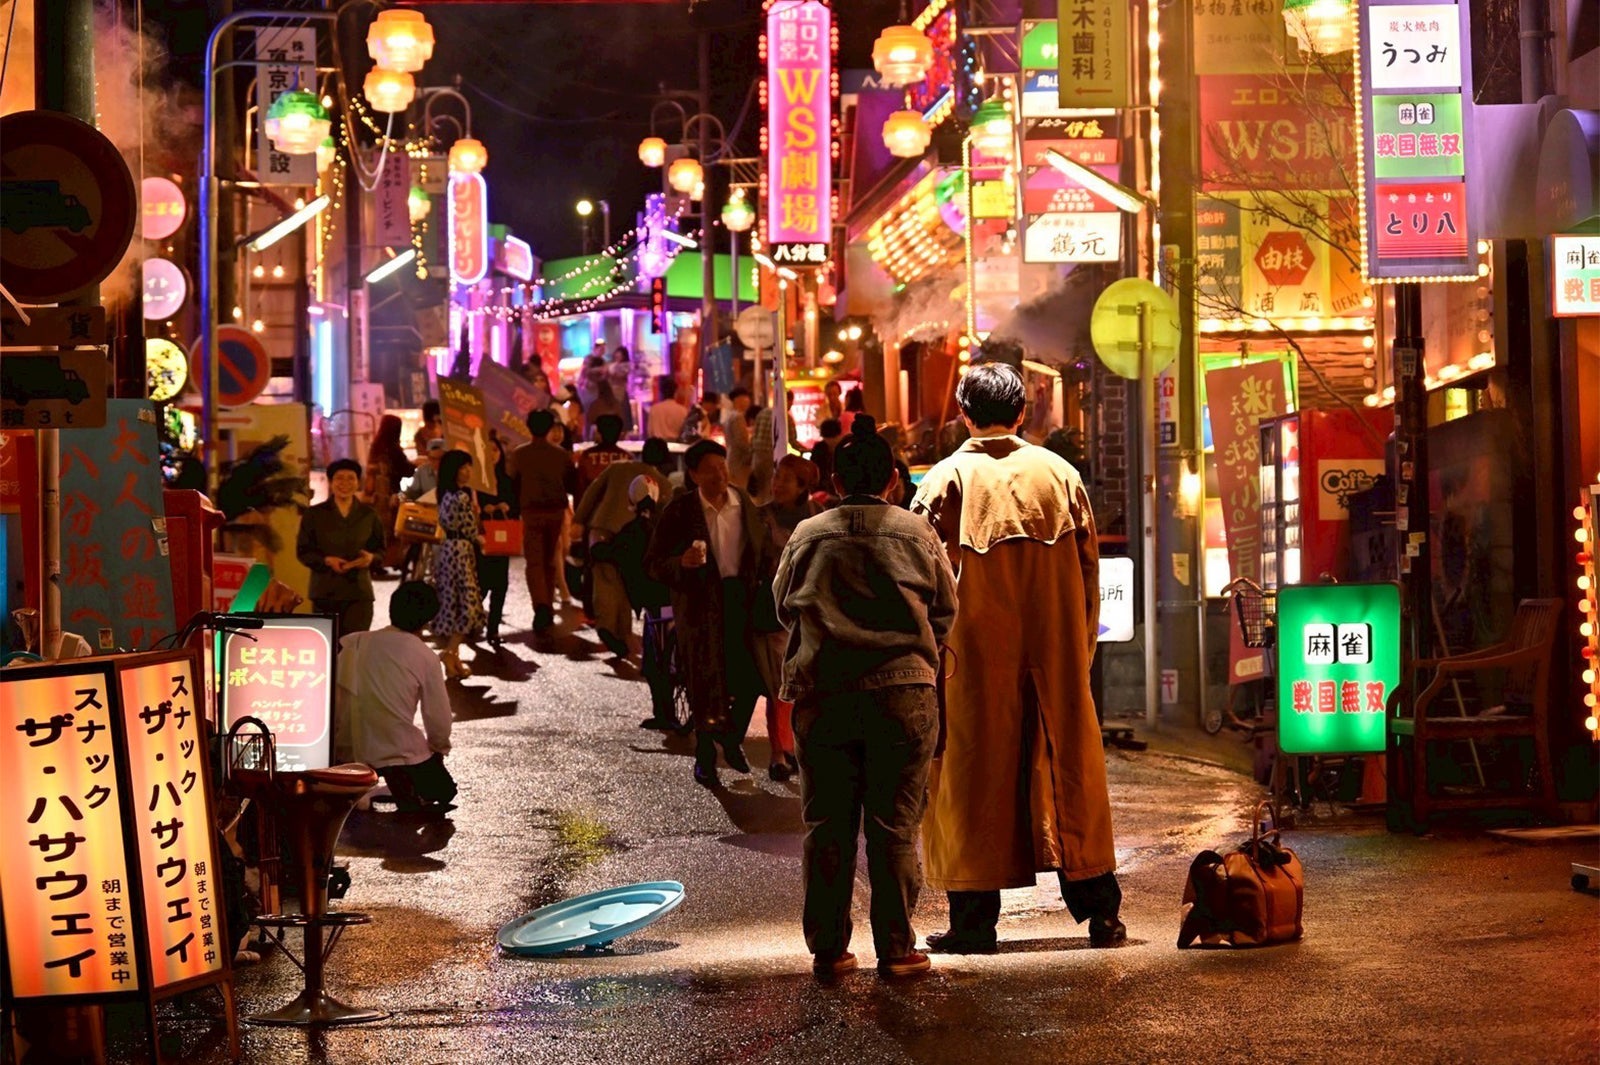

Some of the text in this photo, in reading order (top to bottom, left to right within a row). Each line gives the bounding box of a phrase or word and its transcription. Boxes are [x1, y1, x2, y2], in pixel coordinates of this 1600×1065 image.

[1389, 20, 1440, 32] 炭火焼肉
[1072, 0, 1095, 80] 木歯科
[1382, 42, 1448, 67] うつみ
[1401, 107, 1431, 122] 麻雀
[1376, 133, 1461, 157] 戦国無双
[1388, 192, 1452, 203] やきとり
[1386, 212, 1456, 236] とり八
[240, 647, 316, 666] ビストロ
[1308, 633, 1363, 656] 麻雀
[229, 668, 327, 688] ボヘミアン
[1293, 680, 1386, 713] 戦国無双
[172, 675, 197, 794] スナック
[74, 688, 111, 810] スナック
[194, 861, 216, 964] 朝まで営業中
[102, 879, 131, 984] 朝まで営業中
